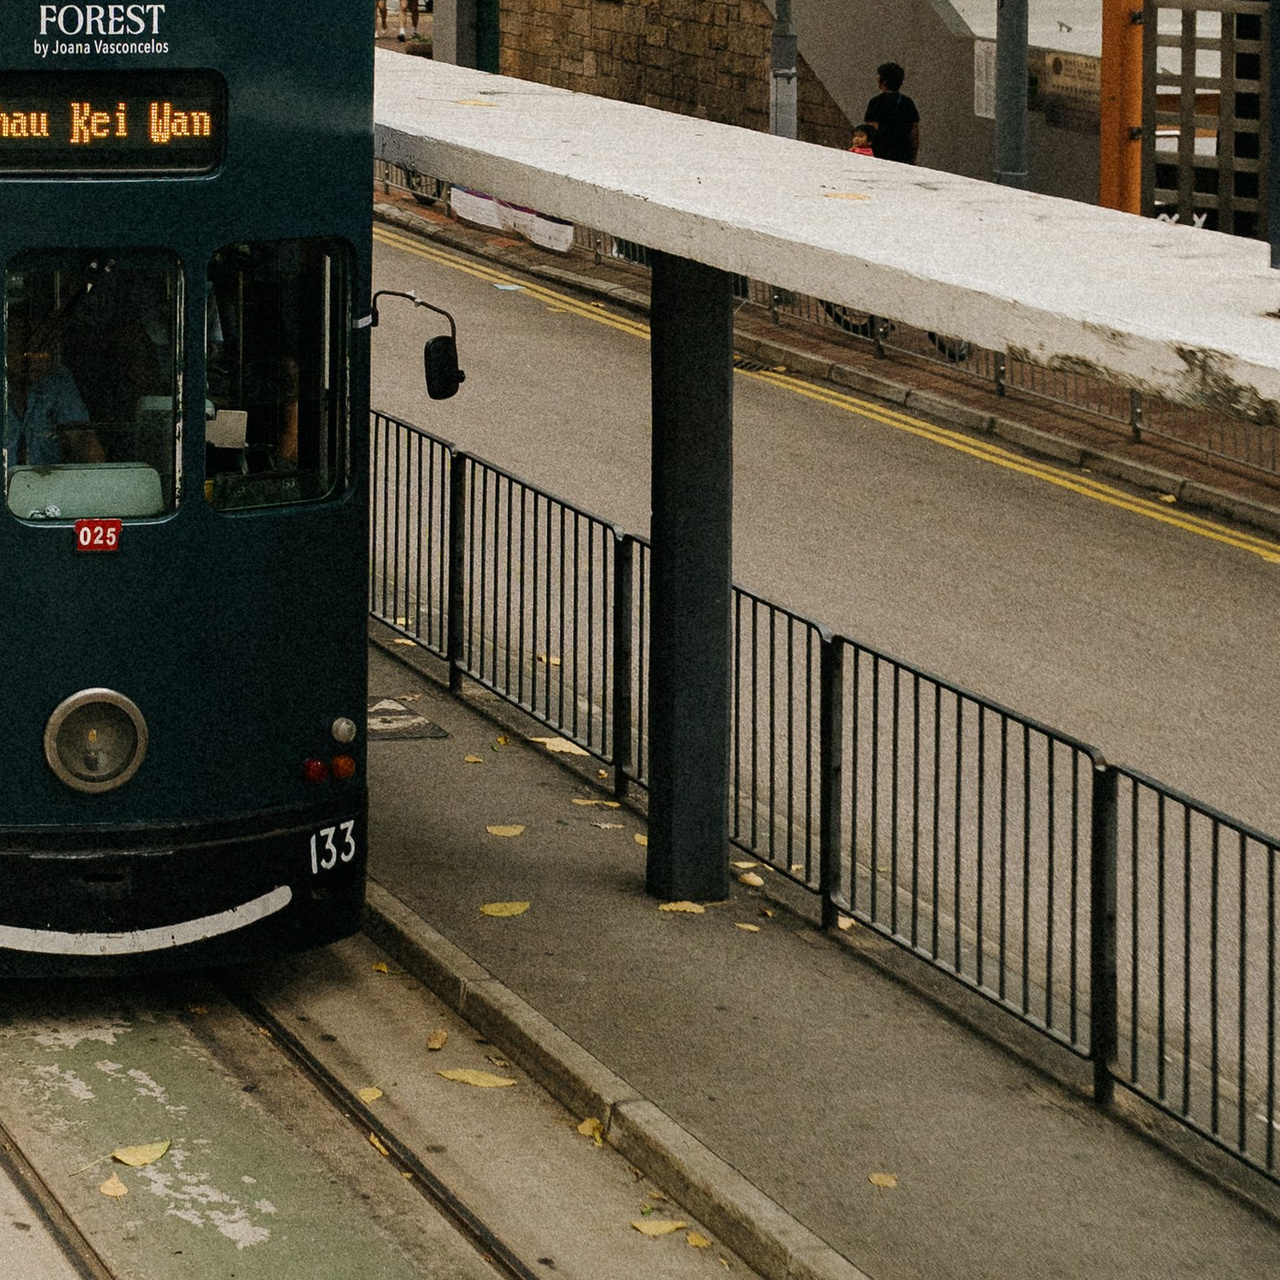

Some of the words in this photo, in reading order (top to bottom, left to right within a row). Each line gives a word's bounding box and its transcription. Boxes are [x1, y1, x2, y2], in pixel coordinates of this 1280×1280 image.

[39, 4, 166, 35] FOREST
[34, 39, 48, 58] by
[52, 39, 91, 55] Joana
[94, 38, 169, 55] Vasconcelos
[70, 102, 128, 144] Kei
[150, 102, 211, 144] Wan
[79, 526, 116, 546] 025
[310, 819, 356, 874] 133
